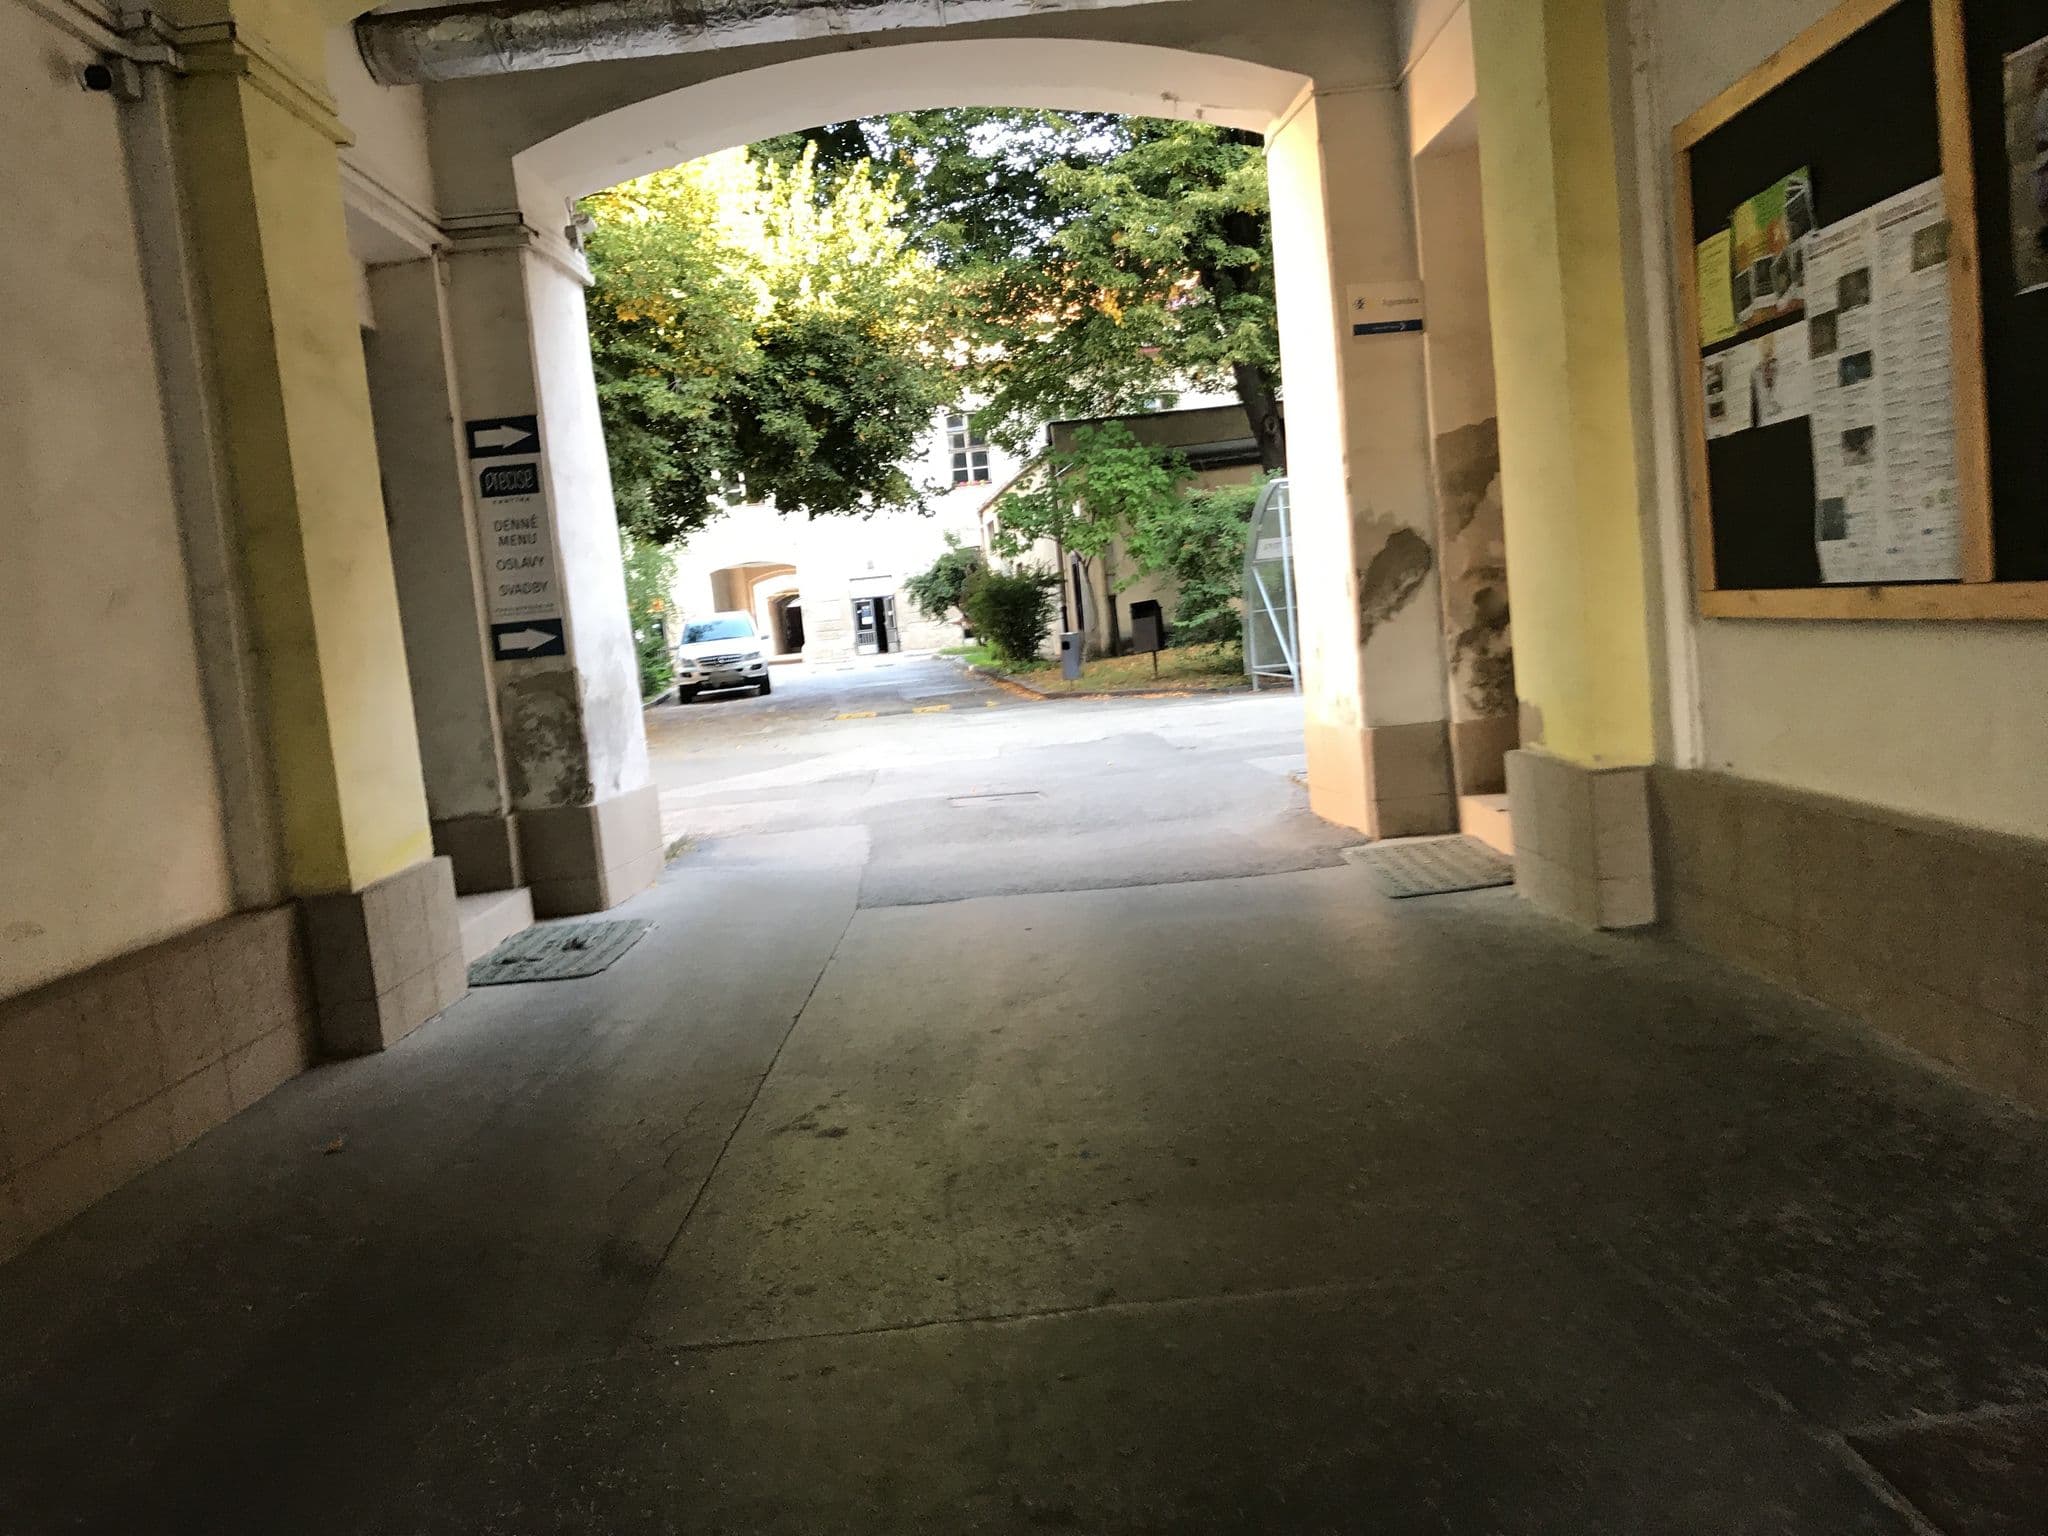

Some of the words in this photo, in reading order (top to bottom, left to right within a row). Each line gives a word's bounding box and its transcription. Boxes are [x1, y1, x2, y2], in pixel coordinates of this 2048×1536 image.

[494, 513, 538, 532] DENNÉ
[496, 555, 545, 571] OSLAVY
[499, 580, 549, 597] SVADBY
